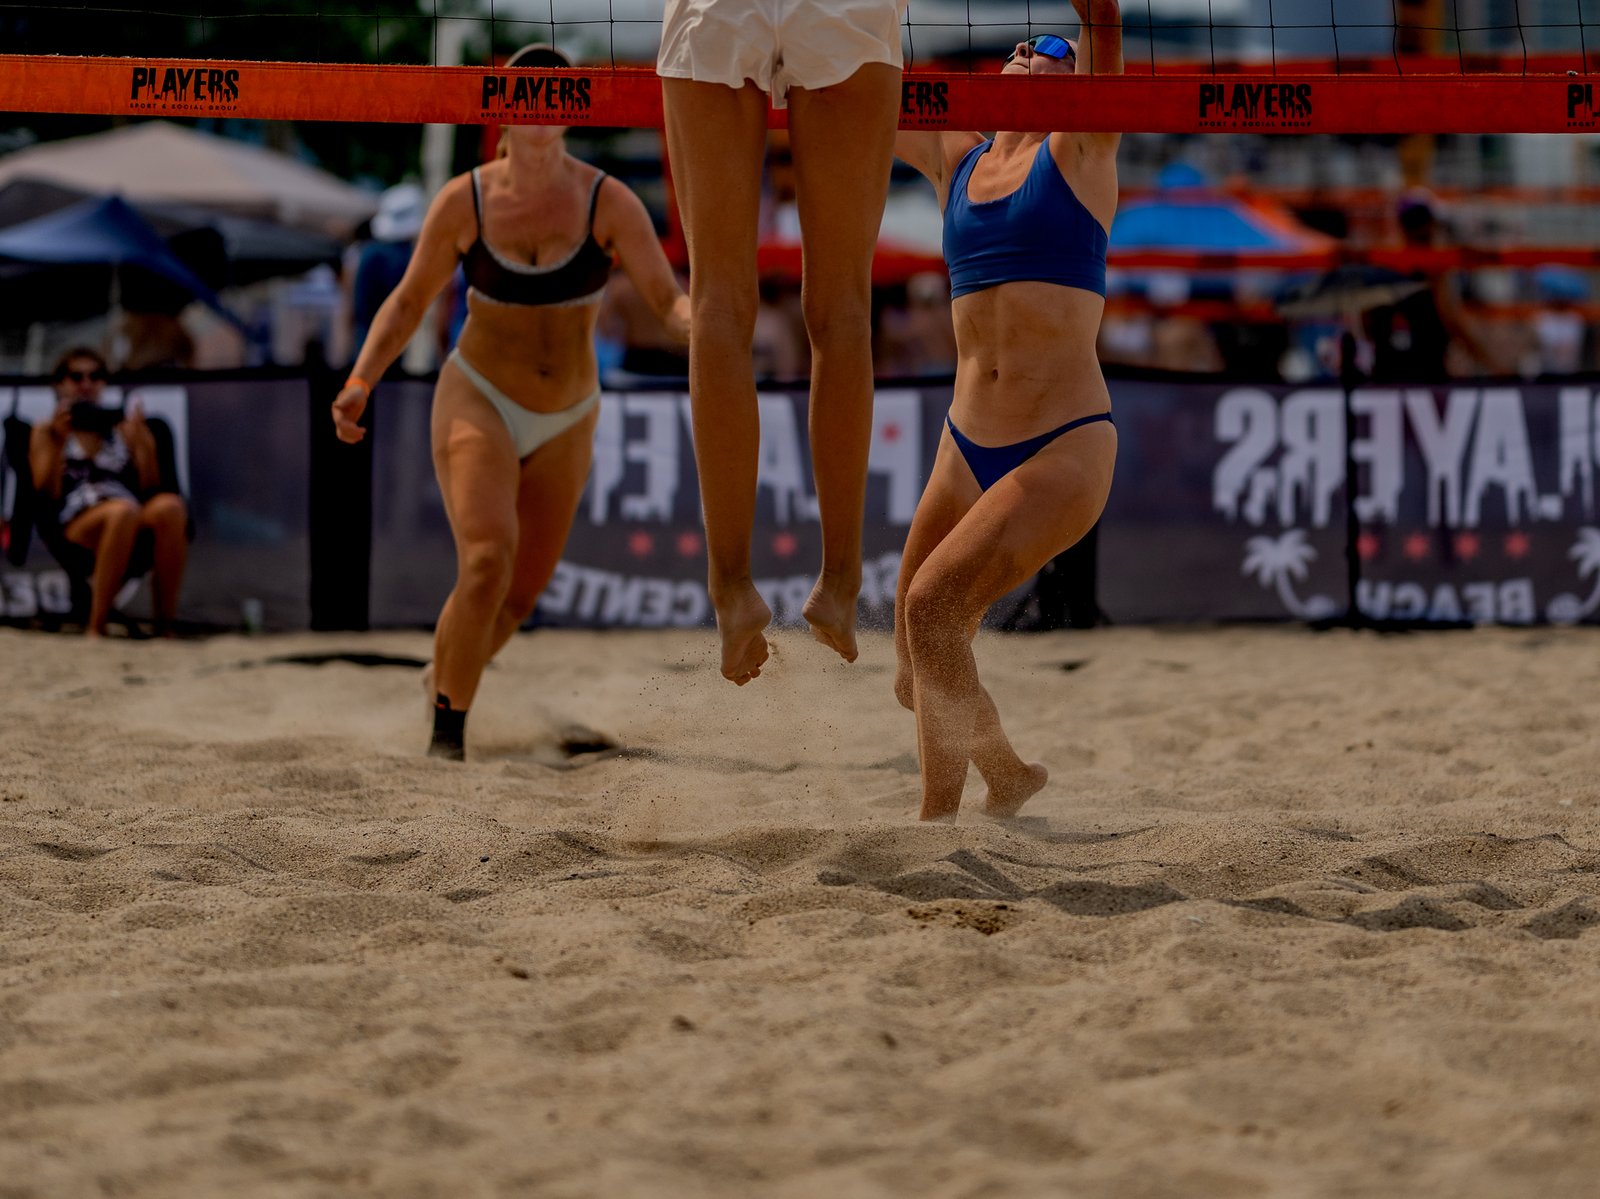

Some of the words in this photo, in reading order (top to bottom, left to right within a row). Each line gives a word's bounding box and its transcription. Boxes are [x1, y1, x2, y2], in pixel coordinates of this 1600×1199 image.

[130, 67, 240, 103] PLAYERS
[481, 75, 591, 111] PLAYERS
[1199, 83, 1313, 119] PLAYERS
